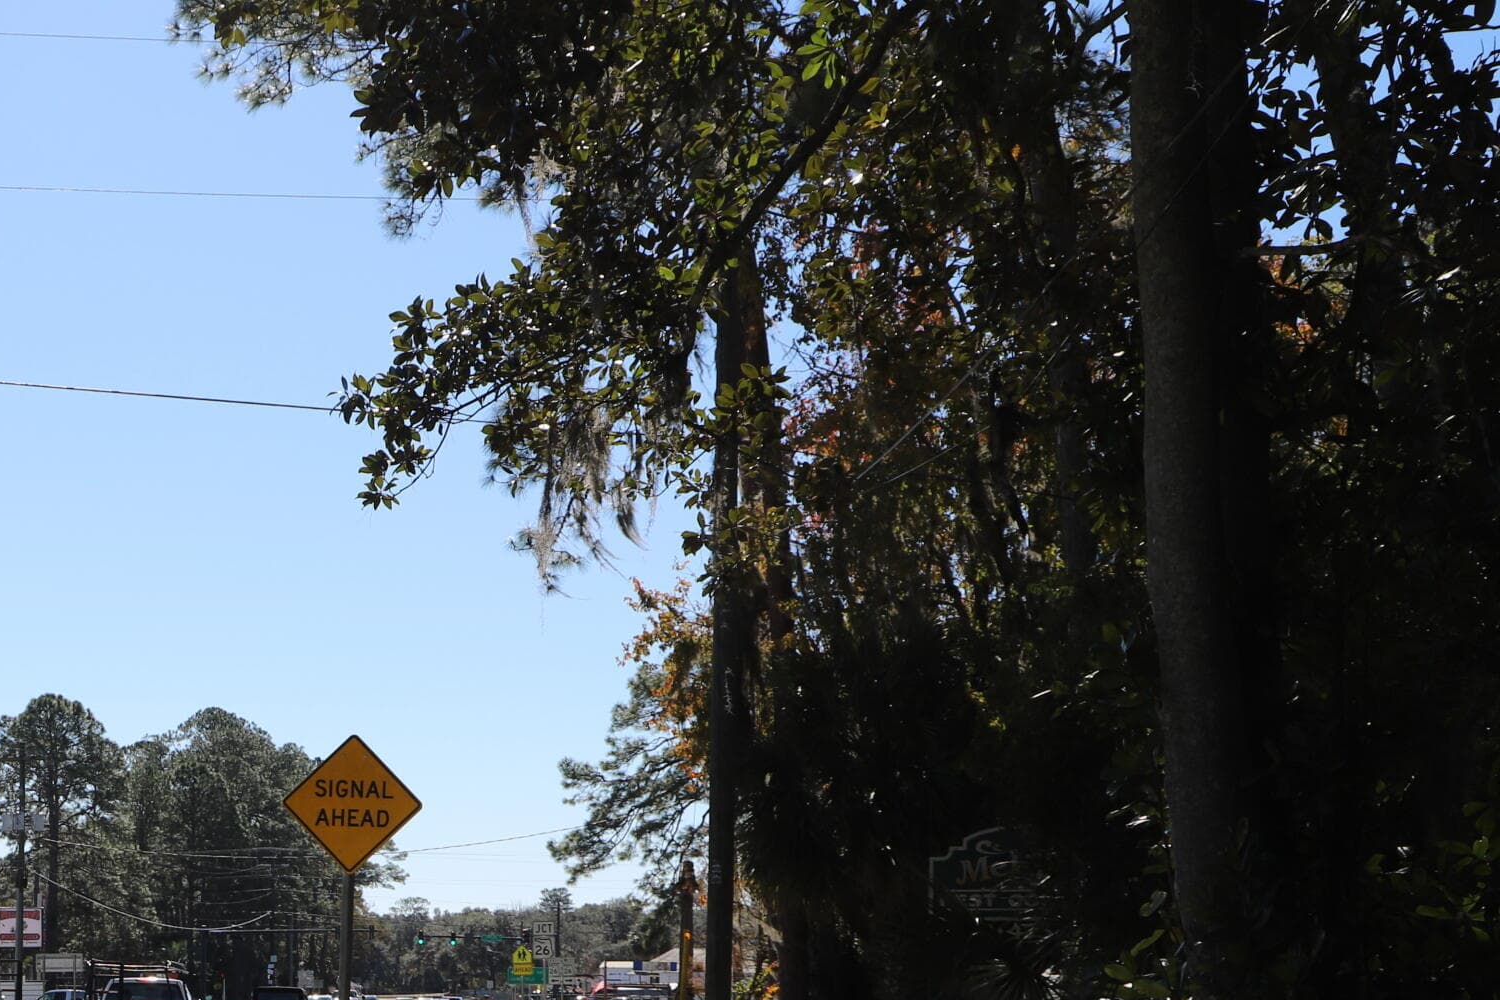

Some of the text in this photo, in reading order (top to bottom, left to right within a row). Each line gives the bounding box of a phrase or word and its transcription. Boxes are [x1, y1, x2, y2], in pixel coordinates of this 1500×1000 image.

[315, 779, 394, 799] SIGNAL
[315, 808, 390, 828] AHEAD
[535, 924, 552, 933] JCT
[535, 945, 550, 956] 26
